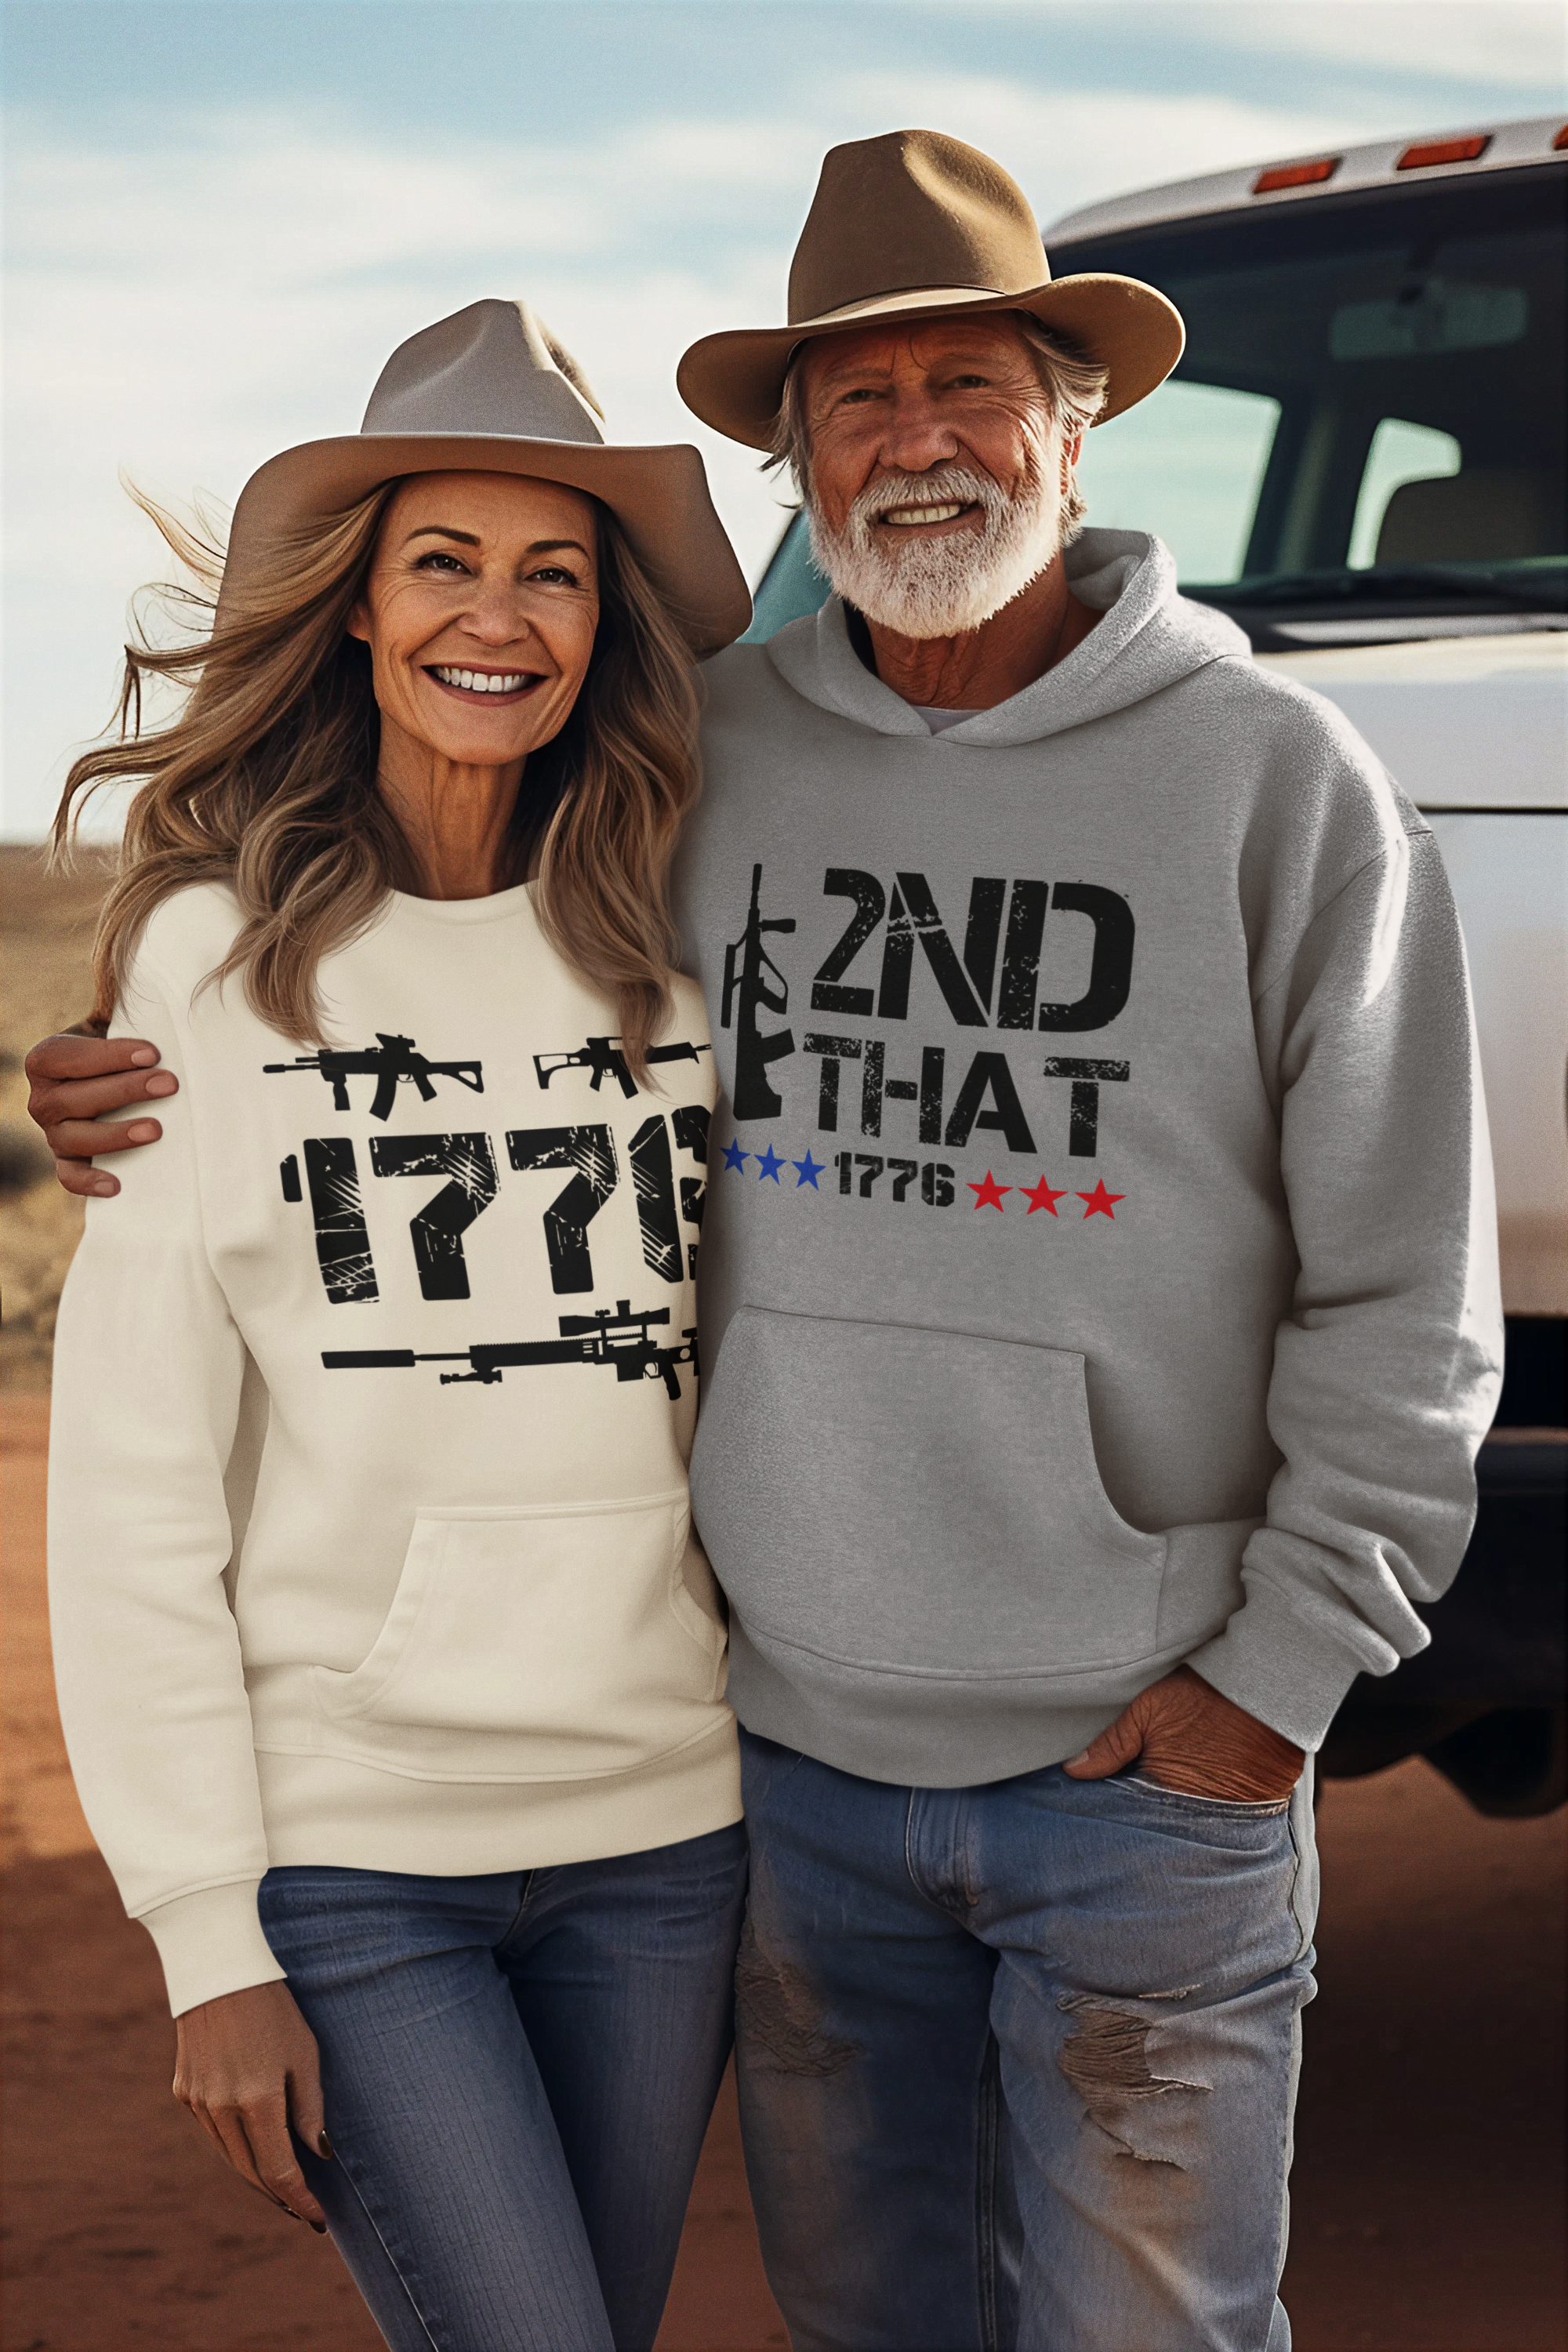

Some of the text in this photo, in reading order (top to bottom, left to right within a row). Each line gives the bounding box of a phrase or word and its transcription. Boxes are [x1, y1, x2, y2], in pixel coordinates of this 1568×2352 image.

[811, 867, 1135, 1033] 2ND
[803, 1033, 1131, 1158] THAT
[834, 1151, 955, 1207] 1776
